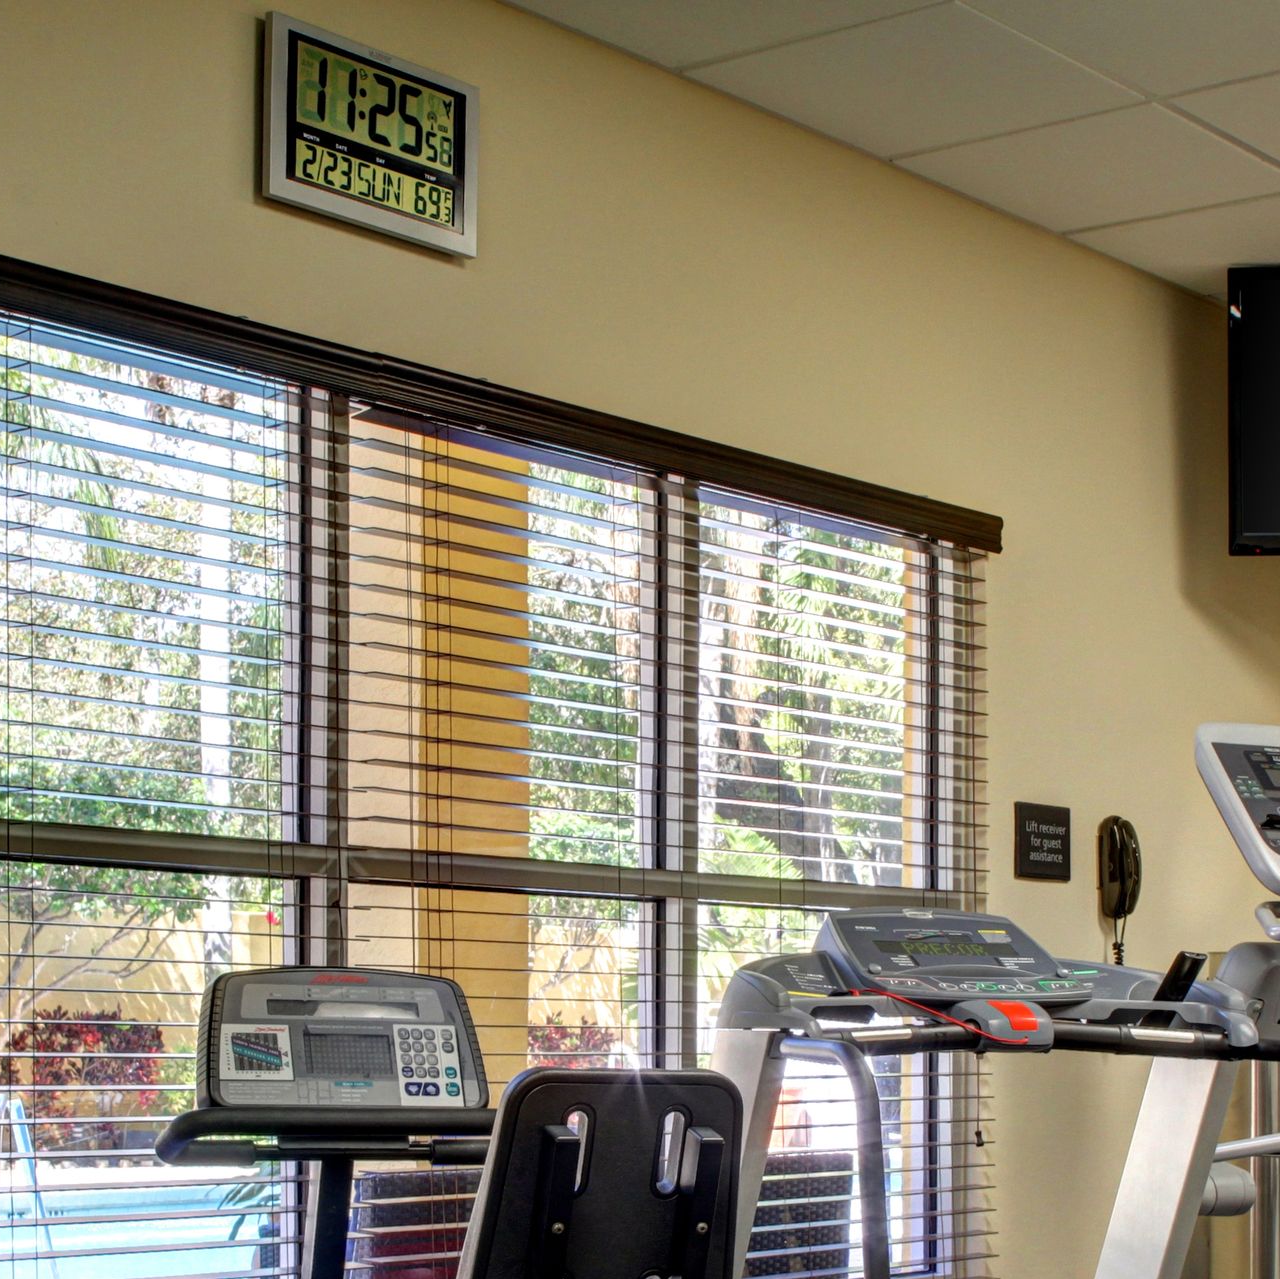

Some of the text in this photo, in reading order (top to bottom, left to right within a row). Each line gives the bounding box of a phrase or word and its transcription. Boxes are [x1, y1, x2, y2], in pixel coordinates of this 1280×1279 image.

[316, 57, 423, 157] 11:25
[358, 162, 401, 206] SUN
[1025, 820, 1066, 836] Lift receiver
[1030, 834, 1062, 851] for guest
[1029, 850, 1063, 863] assistance
